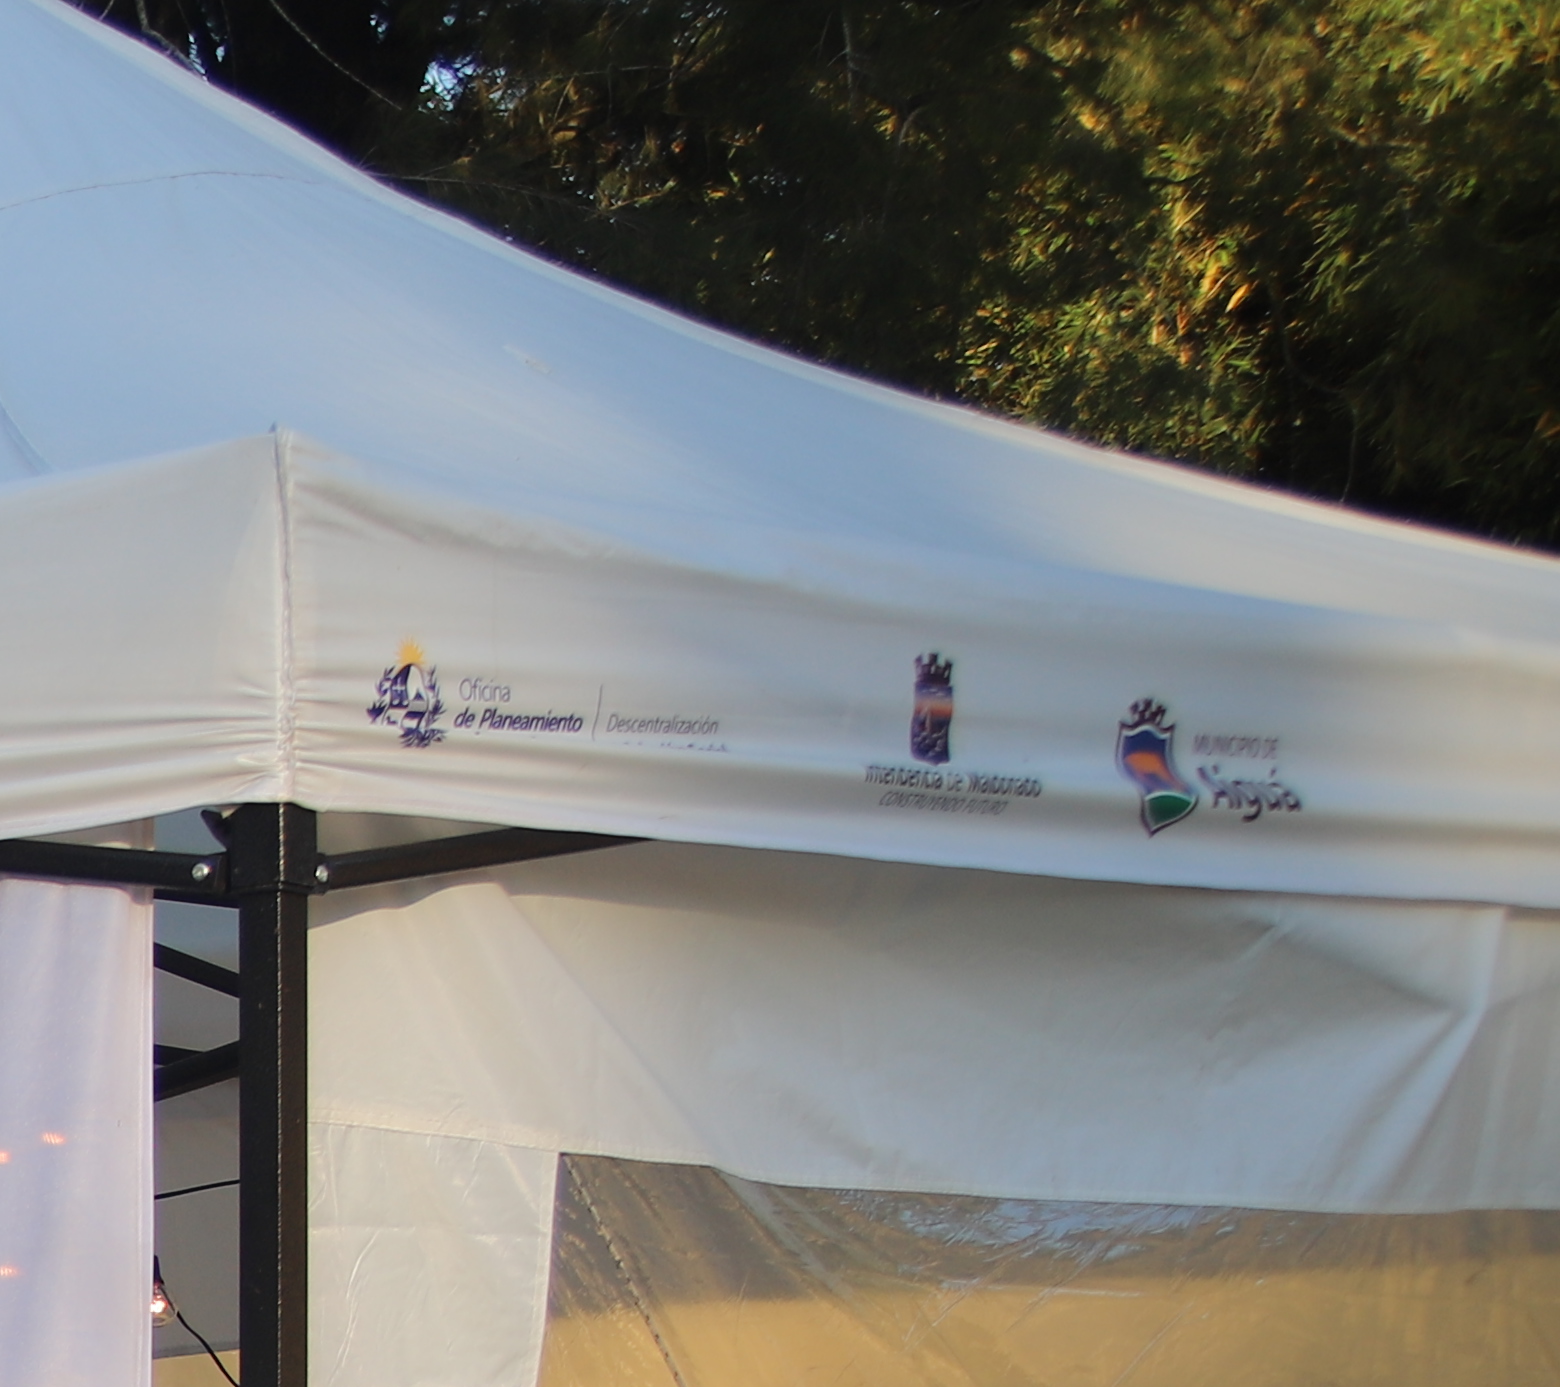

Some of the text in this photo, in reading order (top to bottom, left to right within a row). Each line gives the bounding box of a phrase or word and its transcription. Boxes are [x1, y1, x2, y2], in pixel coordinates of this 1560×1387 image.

[458, 678, 512, 703] Oficina
[453, 707, 584, 733] de Planeamiento
[605, 713, 721, 736] Descentralización
